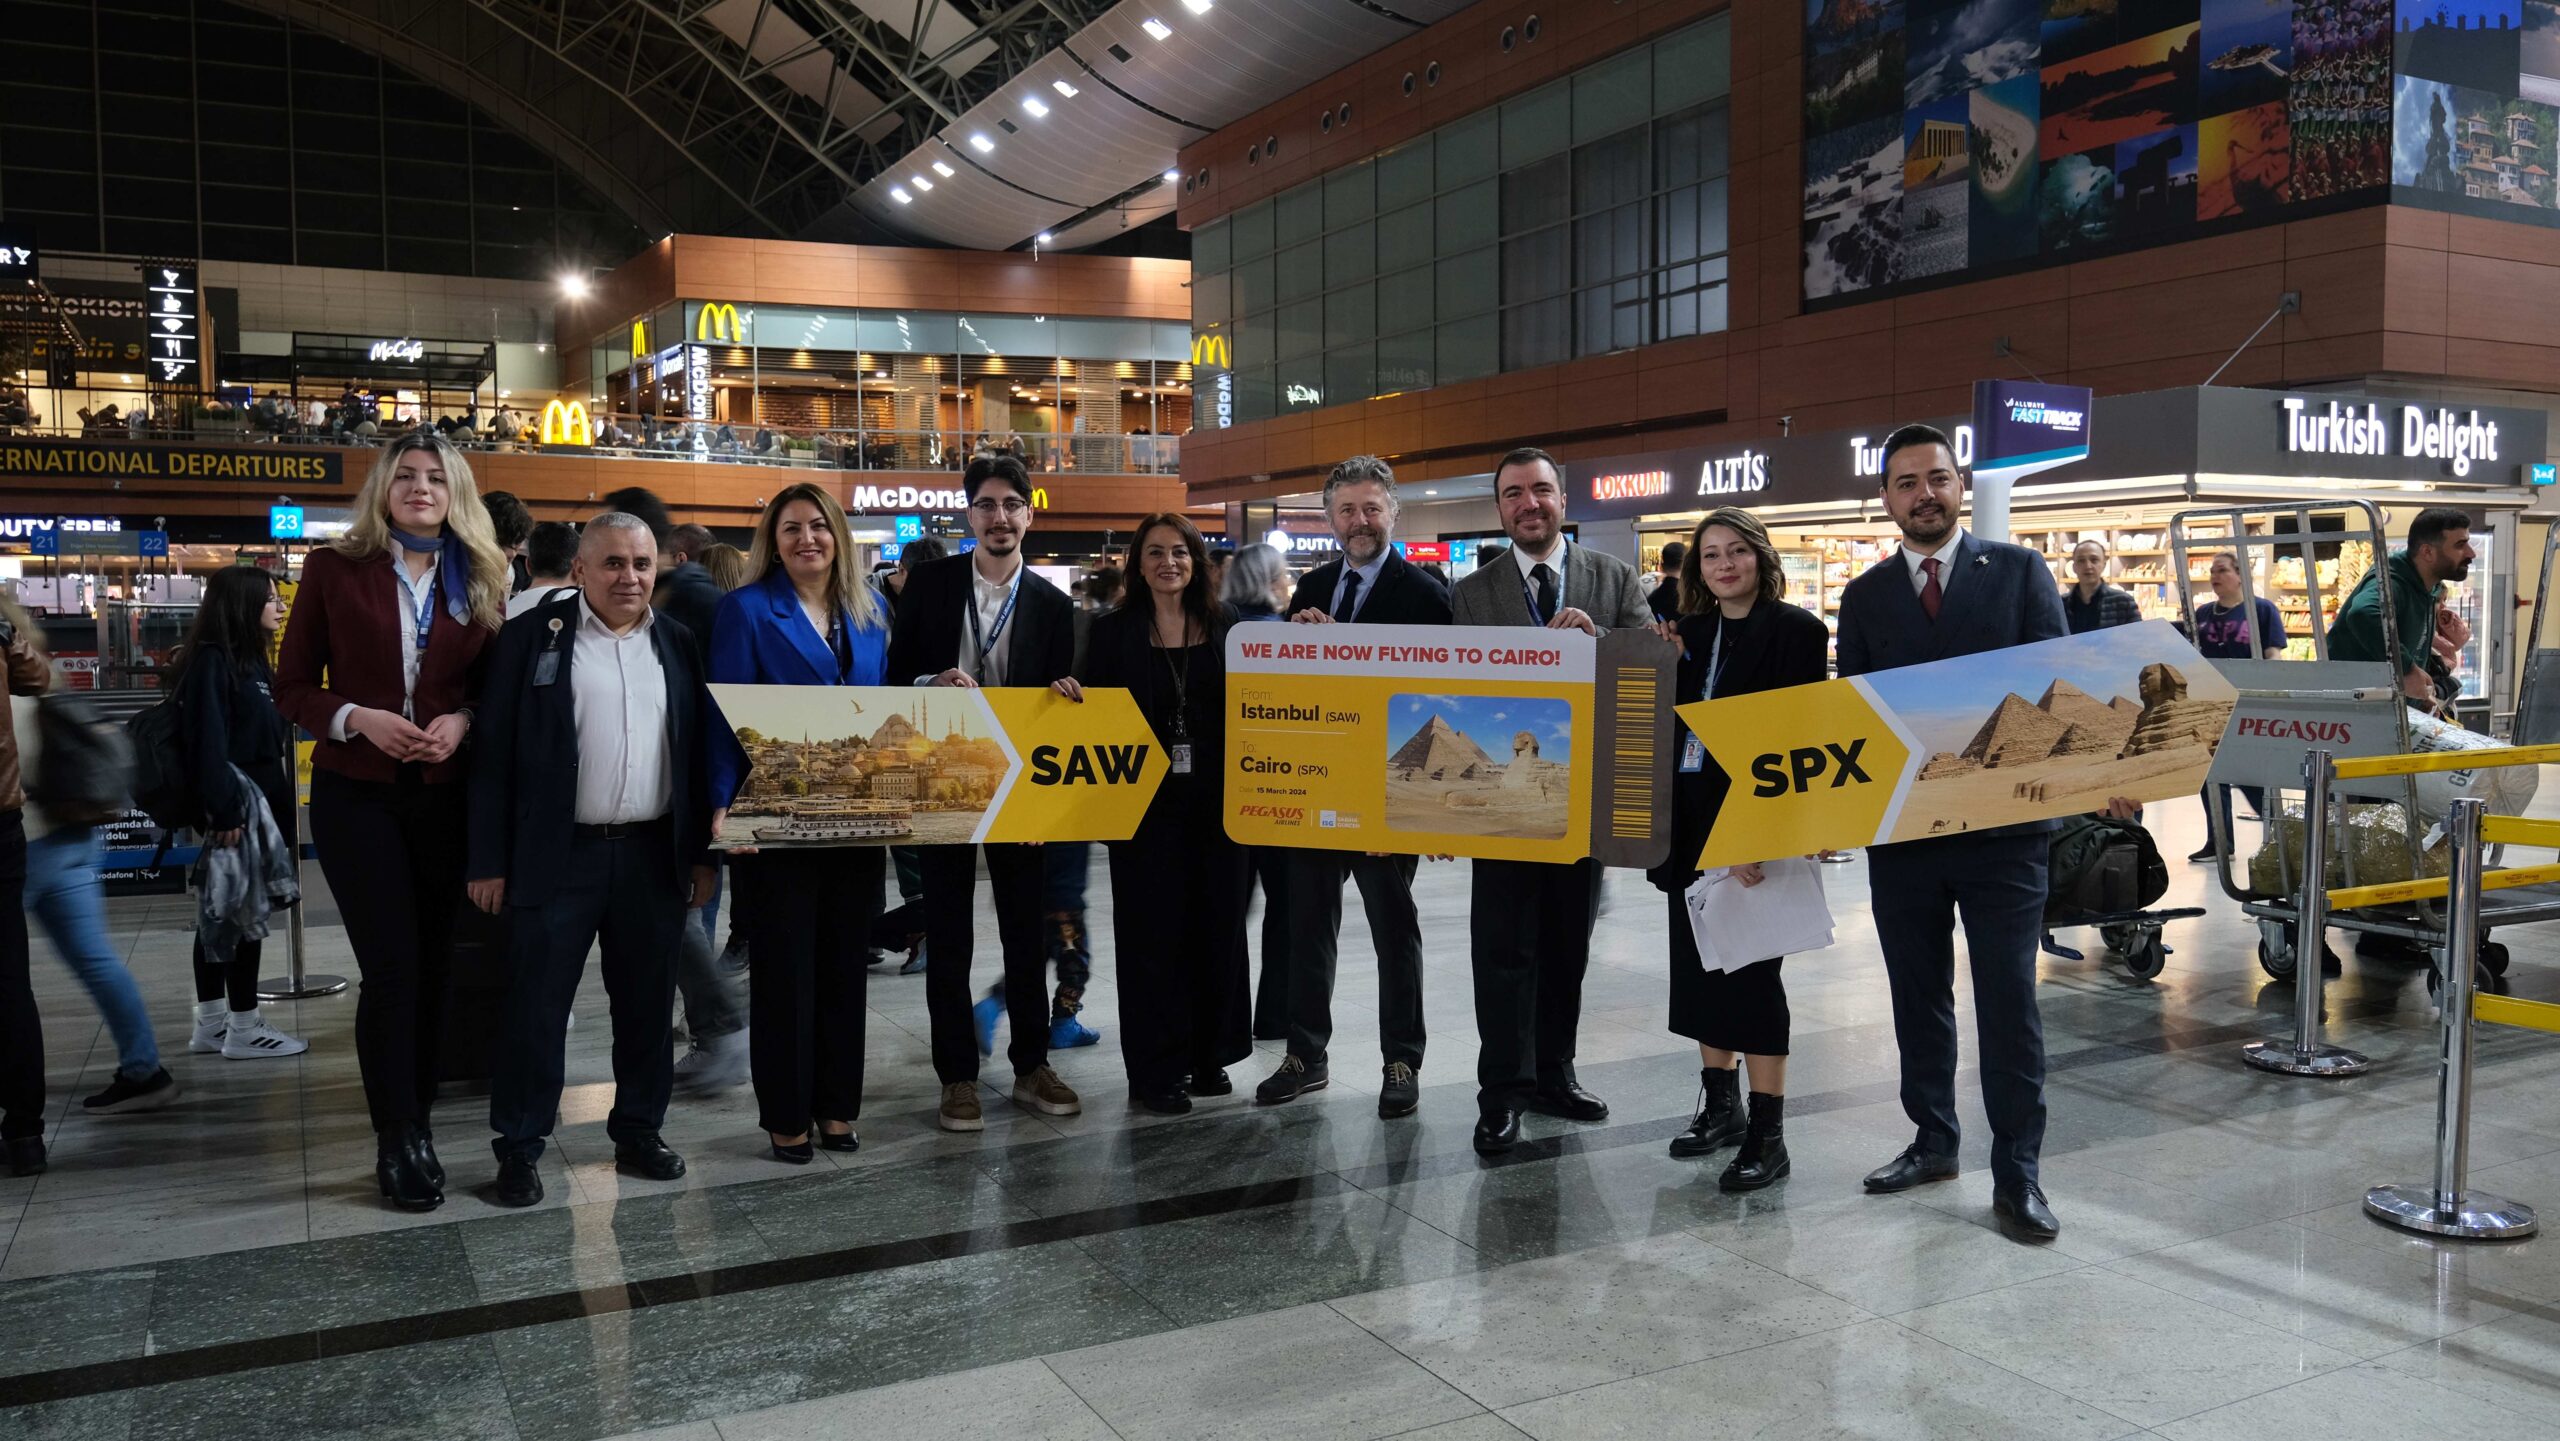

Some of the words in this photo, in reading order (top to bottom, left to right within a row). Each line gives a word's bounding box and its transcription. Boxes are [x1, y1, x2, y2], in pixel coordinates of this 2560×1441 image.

[2284, 398, 2386, 456] Turkish
[2403, 405, 2498, 477] Delight
[168, 453, 326, 480] DEPARTURES
[1591, 471, 1666, 500] LOKKUM
[853, 486, 966, 509] McDona
[275, 514, 298, 530] 23
[900, 523, 918, 537] 28
[36, 535, 54, 549] 21
[144, 537, 163, 550] 22
[1297, 538, 1334, 551] DUTY
[884, 544, 899, 556] 29
[1454, 547, 1461, 557] 2
[1241, 643, 1272, 658] WE
[1277, 644, 1317, 660] ARE
[1323, 645, 1373, 661] NOW
[1378, 646, 1449, 663] FLYING
[1454, 648, 1483, 665] TO
[1488, 649, 1561, 666] CAIRO!
[1241, 688, 1273, 701] From:
[1241, 702, 1320, 722] Istanbul
[1325, 711, 1361, 725] (SAW)
[2237, 717, 2351, 745] PEGASUS
[1241, 740, 1257, 753] To:
[1030, 744, 1150, 786] SAW
[1240, 755, 1292, 775] Cairo
[1297, 764, 1329, 778] (SPX)
[1751, 738, 1873, 798] SPX
[1266, 787, 1287, 795] March
[1288, 788, 1307, 796] 2024
[1239, 805, 1305, 820] PEGASUS
[143, 820, 156, 829] da
[1274, 818, 1301, 827] AIRLINES
[105, 832, 129, 840] dolu
[96, 872, 134, 880] vodafone
